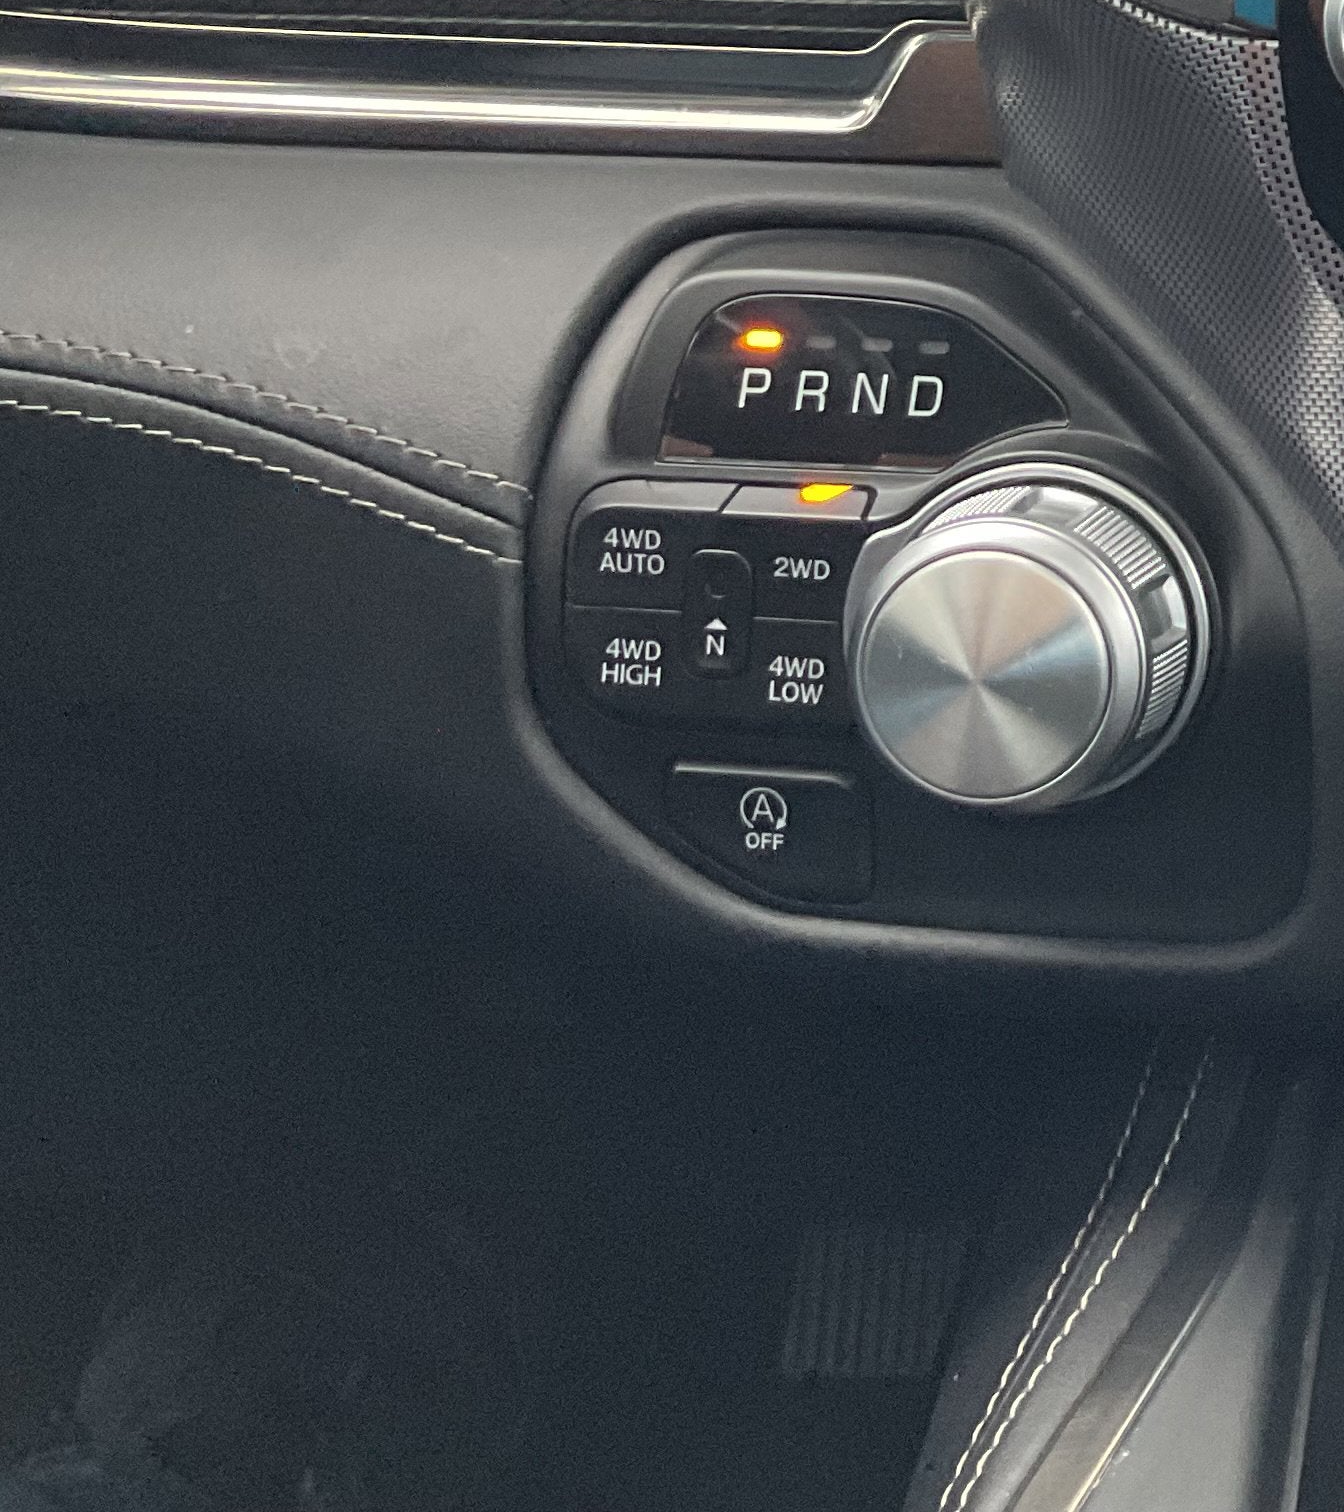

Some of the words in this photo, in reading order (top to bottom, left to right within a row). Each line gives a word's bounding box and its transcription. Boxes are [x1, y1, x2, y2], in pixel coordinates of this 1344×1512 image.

[738, 368, 772, 409] P
[793, 370, 828, 412] R
[850, 373, 888, 415] N
[907, 375, 943, 417] D
[603, 527, 661, 550] 4WD
[600, 552, 665, 576] AUTO
[773, 557, 830, 581] 2WD
[605, 639, 661, 662] 4WD
[706, 636, 725, 656] N
[602, 664, 662, 687] HIGH
[769, 656, 824, 679] 4WD
[769, 681, 823, 704] LOW
[745, 831, 784, 851] OFF
